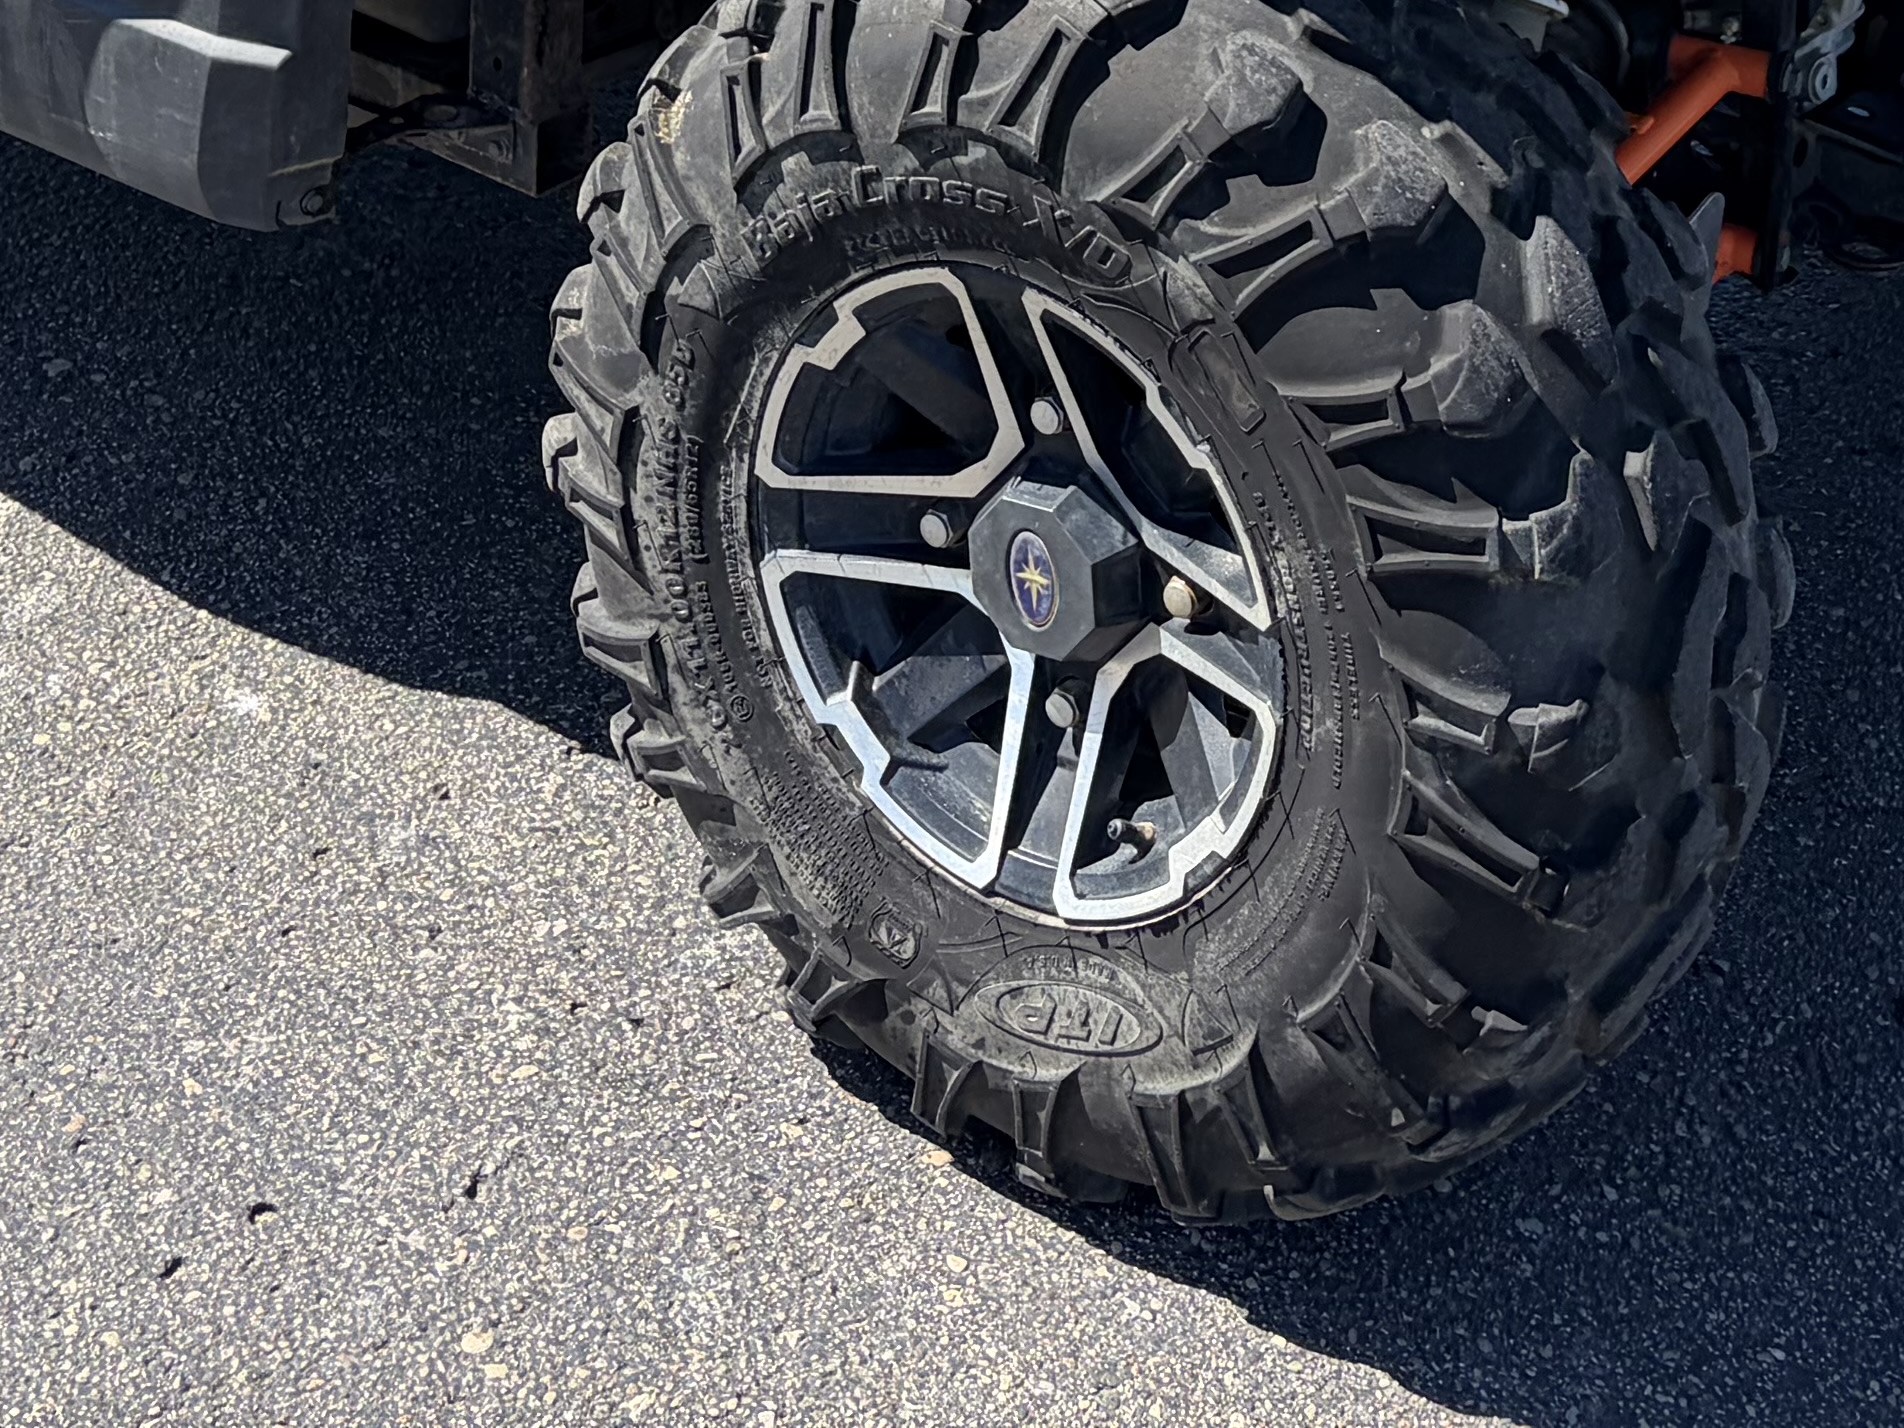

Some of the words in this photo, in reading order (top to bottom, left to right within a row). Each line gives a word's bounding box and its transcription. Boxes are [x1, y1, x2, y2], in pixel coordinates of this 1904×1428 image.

[740, 187, 844, 265] Baja
[851, 164, 1011, 216] Cross
[1014, 990, 1124, 1047] ITP
